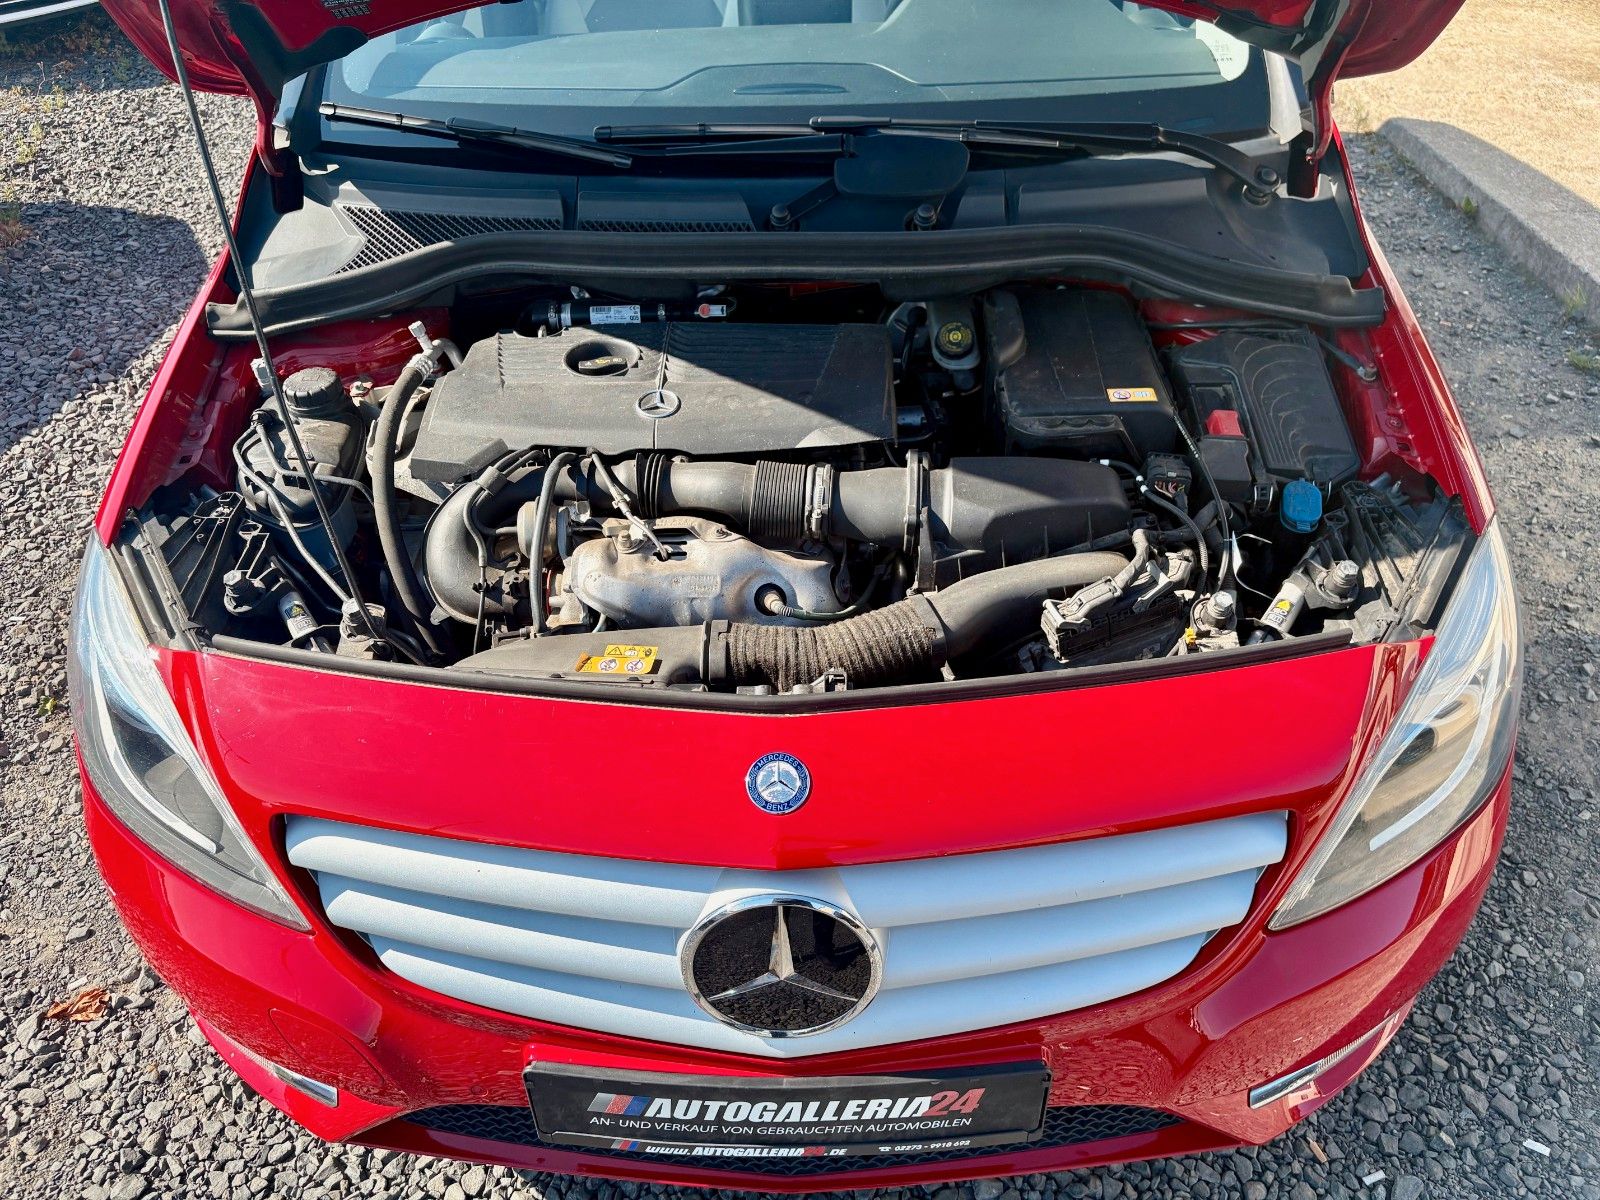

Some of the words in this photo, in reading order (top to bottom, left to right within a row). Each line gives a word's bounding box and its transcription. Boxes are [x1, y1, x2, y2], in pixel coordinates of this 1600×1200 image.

[757, 753, 799, 767] MERCEDES
[766, 802, 790, 811] BENZ
[644, 1088, 986, 1123] AUTOGALLERIA24
[589, 1116, 616, 1126] AN-
[619, 1119, 651, 1129] UND
[654, 1122, 719, 1133] VERKAUF
[721, 1125, 753, 1135] VON
[756, 1124, 863, 1135] GEBRAUCHTEN
[865, 1117, 972, 1132] AUTOMOBILEN
[894, 1144, 922, 1152] 02273
[930, 1141, 952, 1149] 9918
